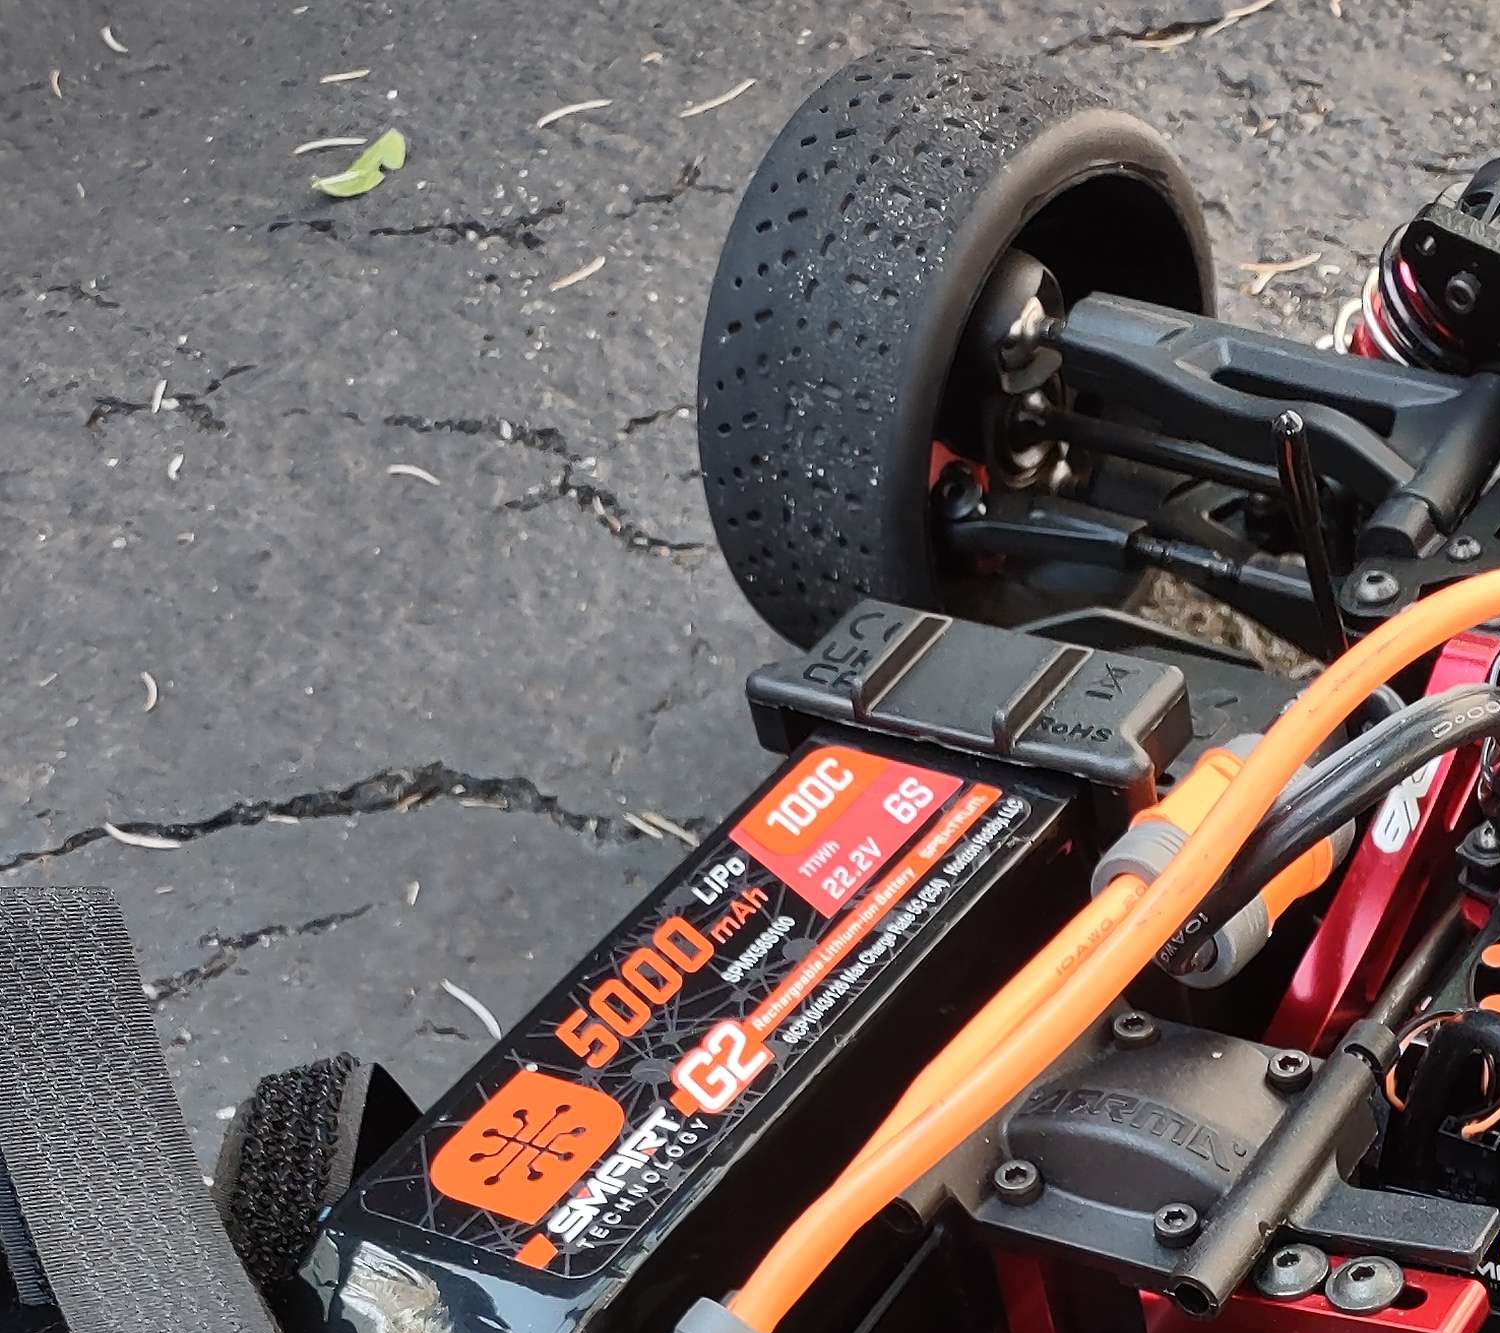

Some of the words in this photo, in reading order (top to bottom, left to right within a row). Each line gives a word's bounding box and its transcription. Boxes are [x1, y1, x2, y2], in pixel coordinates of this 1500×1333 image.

[767, 757, 853, 836] 100C
[883, 777, 935, 825] 6S
[821, 836, 882, 900] 22.2V
[942, 841, 983, 877] Horizon
[710, 886, 769, 944] mAh
[752, 965, 823, 1032] Rechargeable
[876, 866, 917, 912] Battery
[555, 915, 715, 1068] 5000
[678, 1022, 768, 1112] G2
[548, 1106, 682, 1243] SMART
[576, 1118, 709, 1249] TECHNOLOGY
